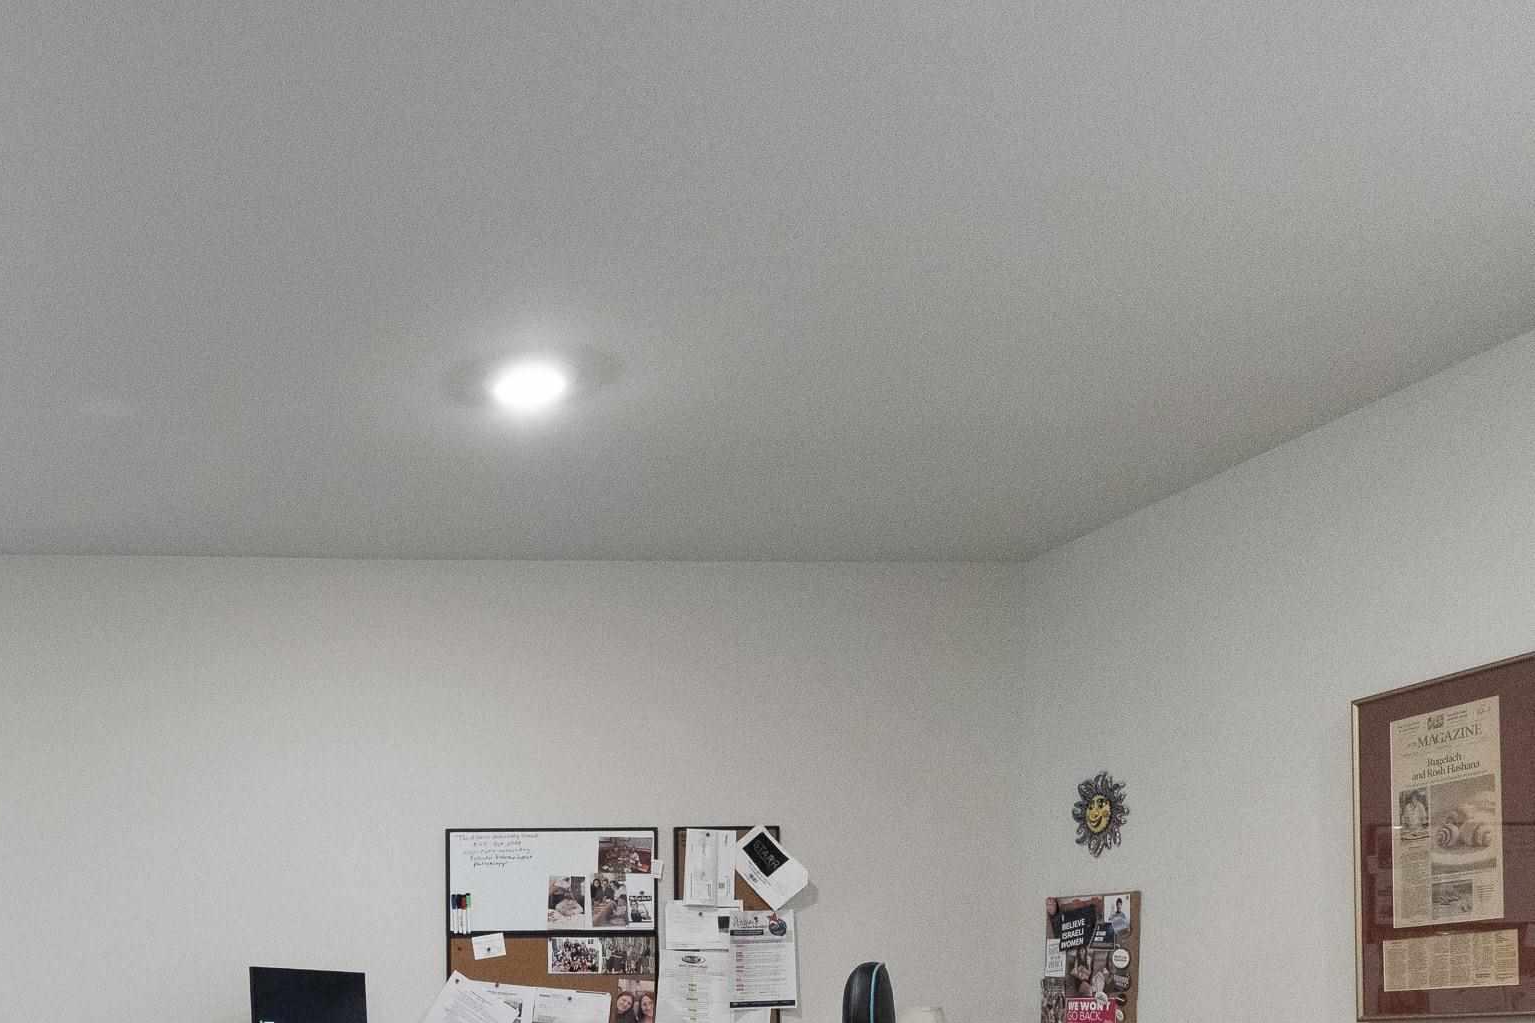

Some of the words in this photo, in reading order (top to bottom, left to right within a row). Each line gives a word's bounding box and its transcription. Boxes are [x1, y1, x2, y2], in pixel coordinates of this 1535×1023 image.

[1417, 723, 1483, 749] MAGAZINE
[1061, 918, 1086, 931] BELIEVE
[1061, 927, 1084, 940] ISRAELI
[1060, 937, 1084, 950] WOMEN
[1067, 1001, 1079, 1011] WE
[1080, 1000, 1111, 1011] WONT
[1079, 1010, 1103, 1021] BACK
